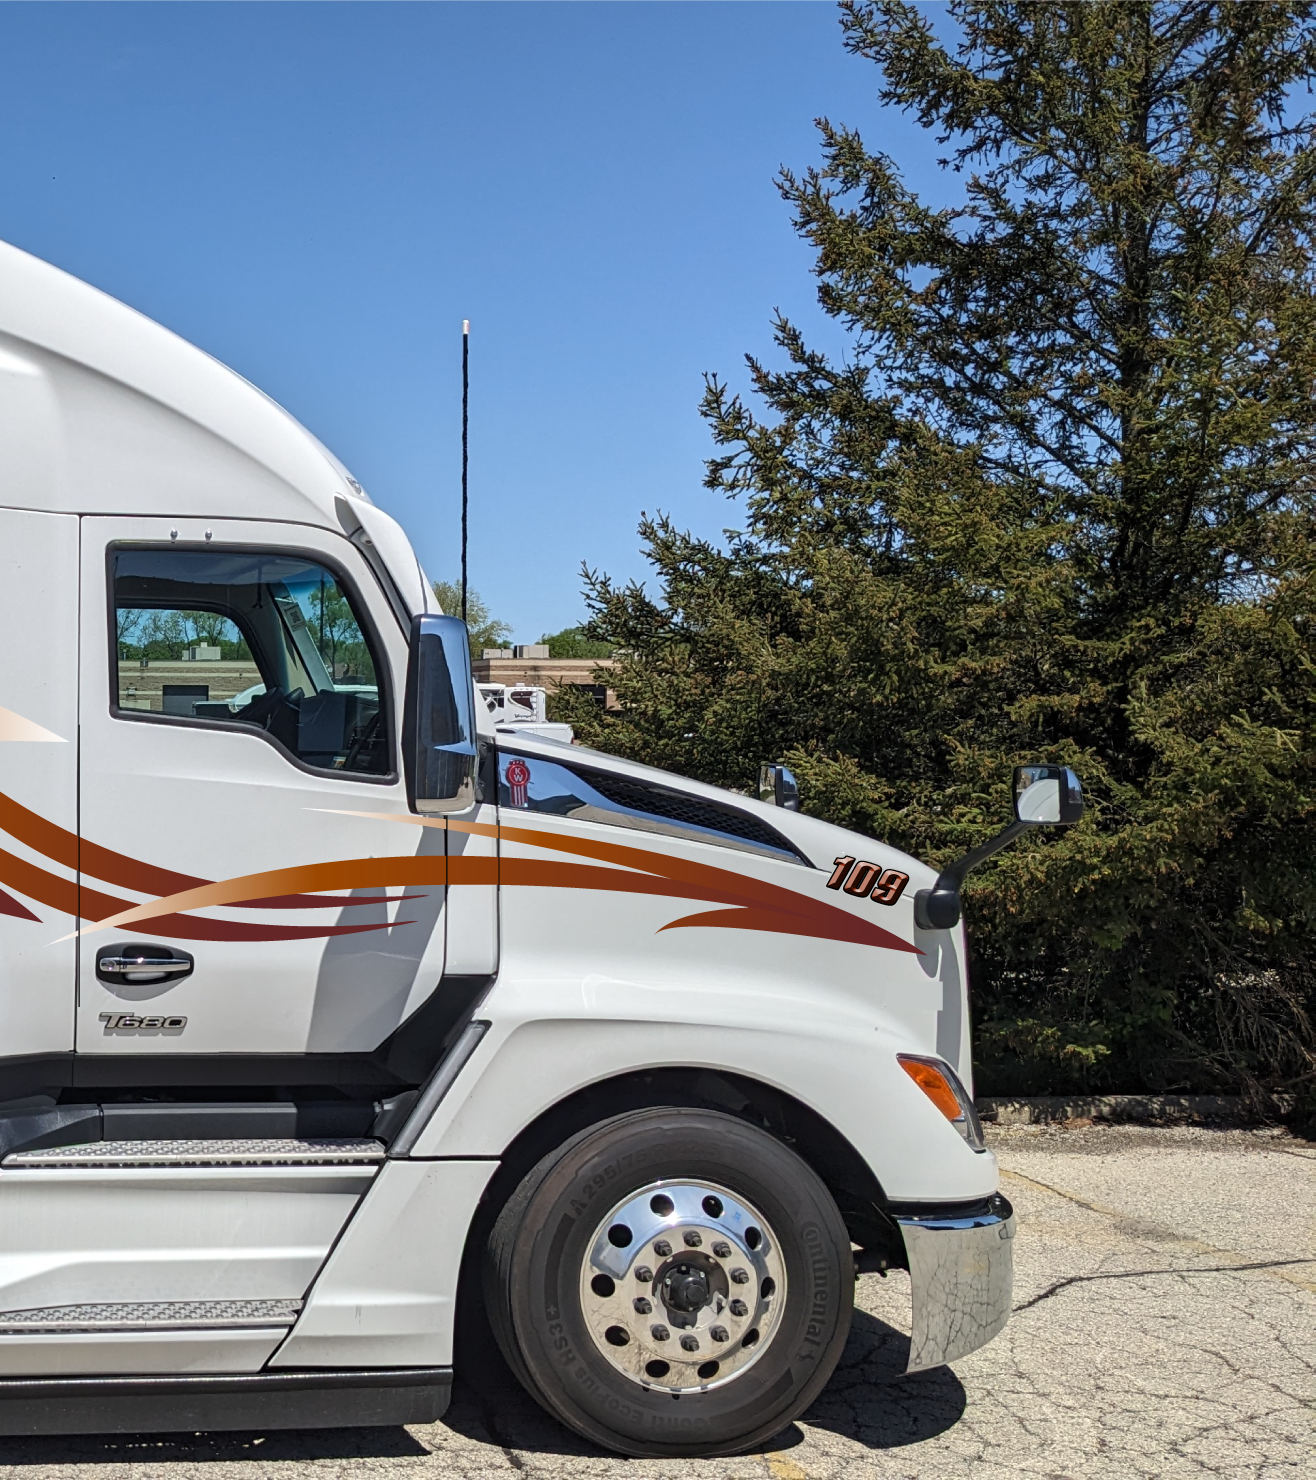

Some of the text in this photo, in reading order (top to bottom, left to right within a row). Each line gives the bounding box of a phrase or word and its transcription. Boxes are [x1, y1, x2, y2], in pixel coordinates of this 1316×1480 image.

[826, 855, 910, 906] 109
[98, 1012, 188, 1029] T680
[800, 1221, 831, 1347] Continental
